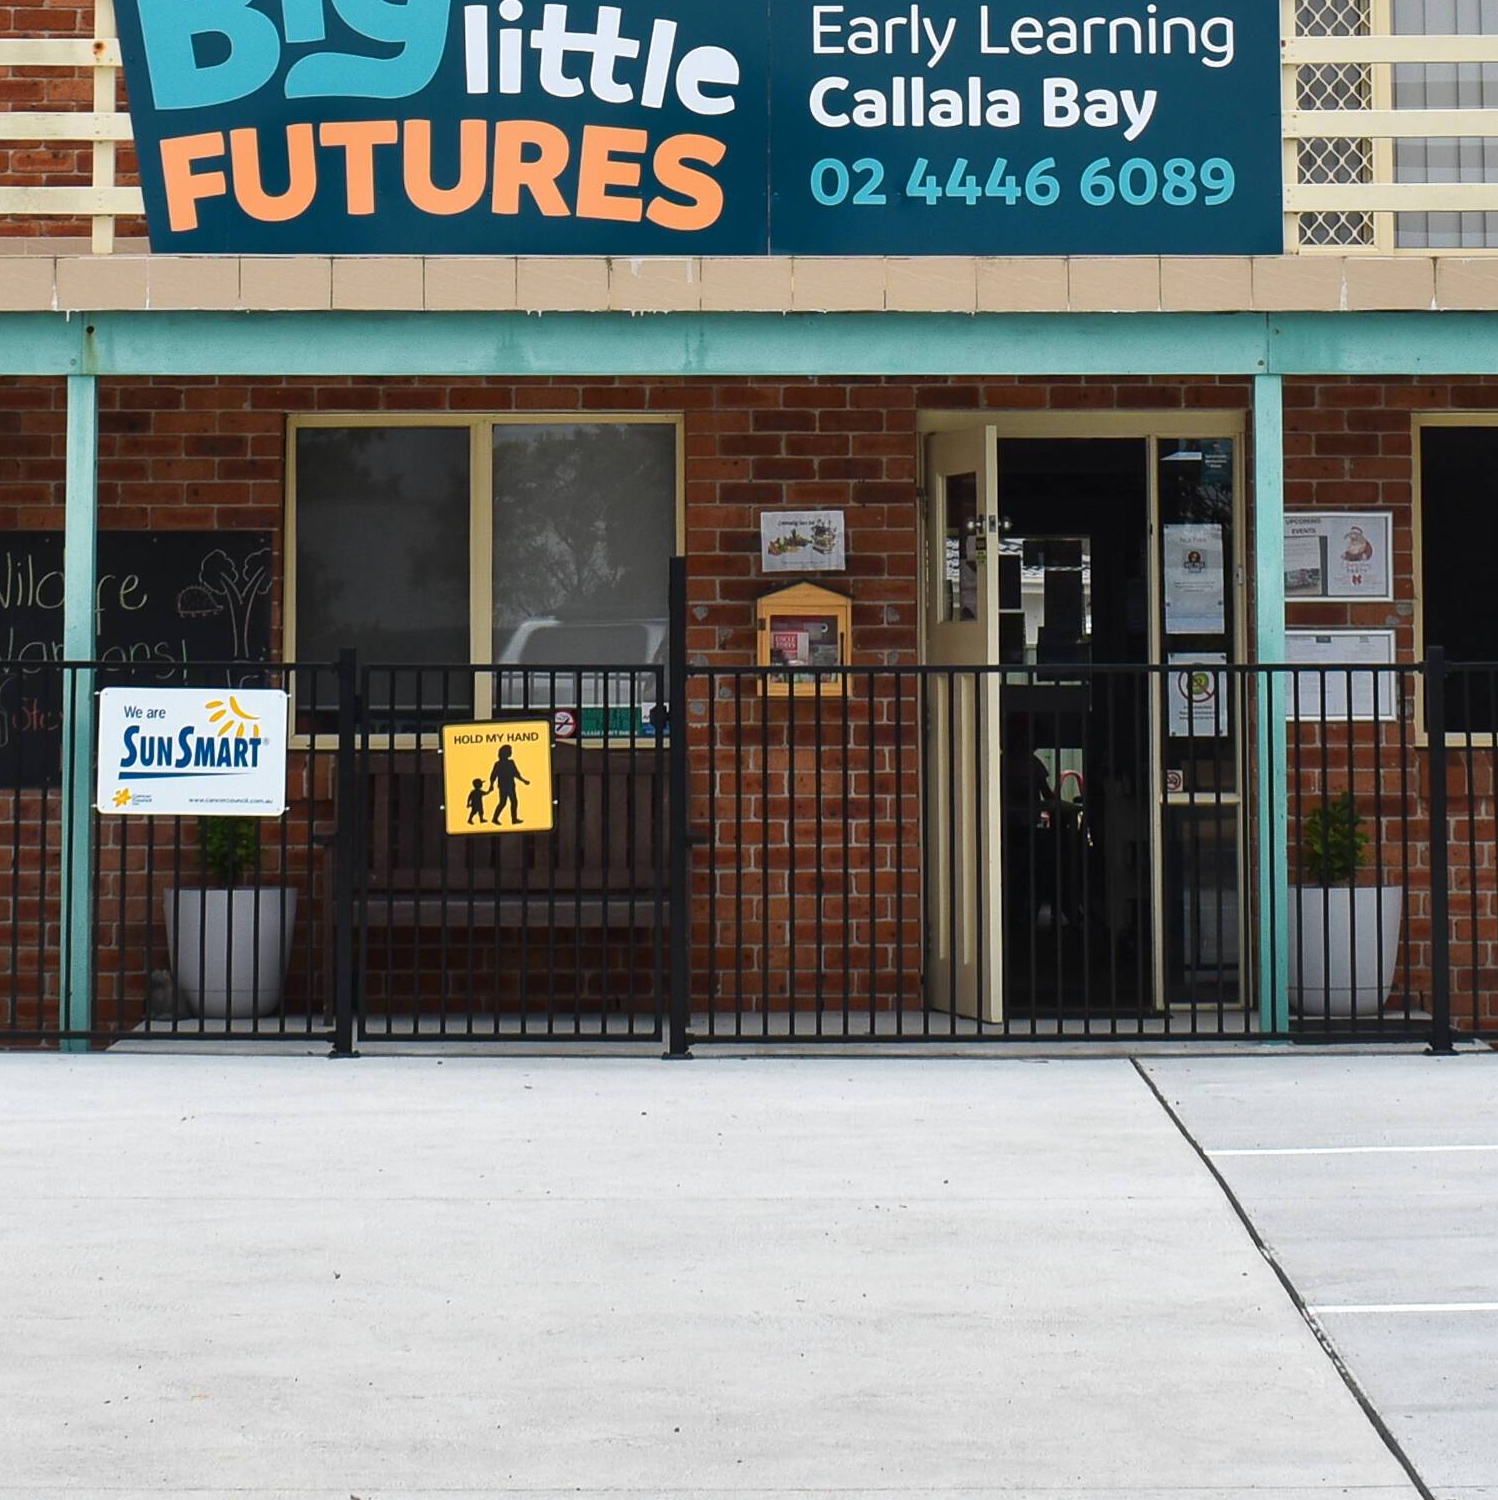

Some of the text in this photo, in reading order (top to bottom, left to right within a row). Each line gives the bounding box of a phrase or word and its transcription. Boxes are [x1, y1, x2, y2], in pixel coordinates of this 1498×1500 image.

[812, 4, 1235, 68] Early Learning
[809, 76, 1158, 141] Callala Bay
[159, 119, 728, 232] FUTURES
[810, 157, 1236, 206] 02 4446 6089
[124, 706, 166, 718] We are
[454, 732, 539, 744] HOLD MY HAND
